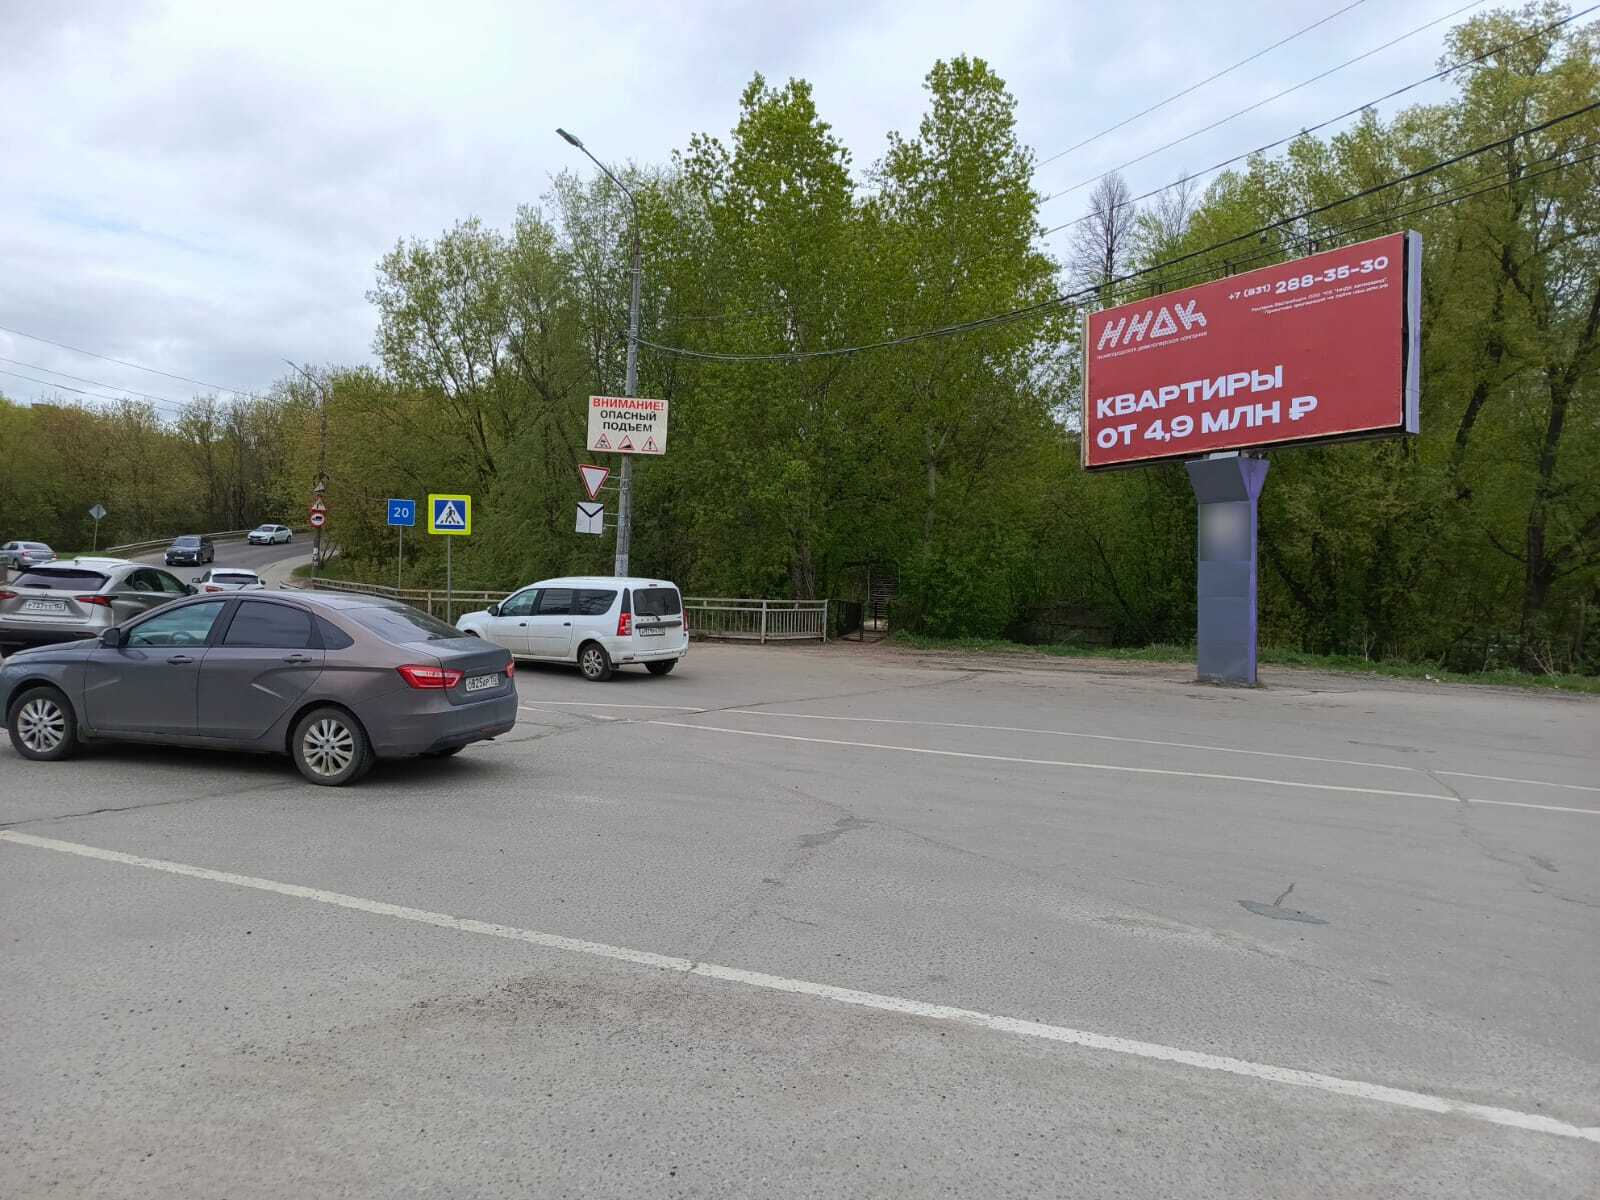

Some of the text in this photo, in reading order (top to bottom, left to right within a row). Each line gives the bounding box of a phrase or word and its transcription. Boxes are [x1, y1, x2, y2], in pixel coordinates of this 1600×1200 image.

[1228, 290, 1241, 300] +7
[1243, 283, 1271, 298] (831)
[1274, 255, 1389, 295] 288-35-30
[1096, 364, 1284, 419] КВАРТИРЫ
[592, 398, 665, 411] ВНИМАНИЕ!
[600, 409, 657, 421] ОПАСНЫЙ
[602, 421, 653, 432] ПОДЪЕМ
[1096, 423, 1138, 449] ОТ
[1143, 415, 1194, 442] 4,9
[1200, 400, 1281, 434] МЛН
[393, 507, 409, 518] 20
